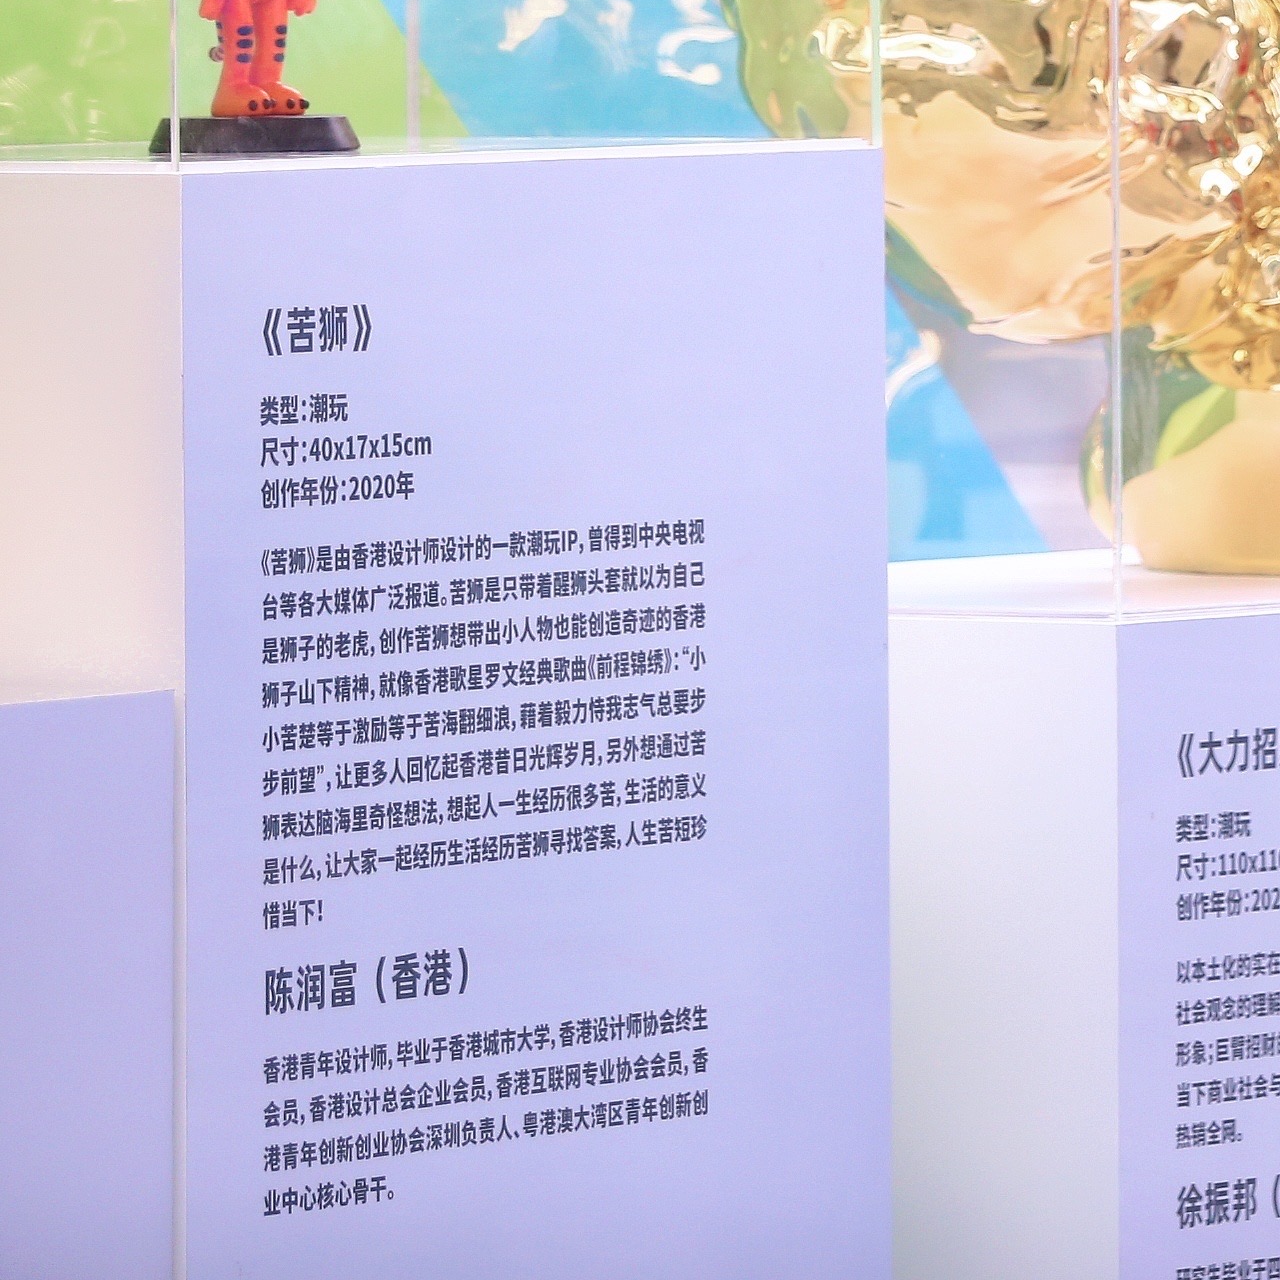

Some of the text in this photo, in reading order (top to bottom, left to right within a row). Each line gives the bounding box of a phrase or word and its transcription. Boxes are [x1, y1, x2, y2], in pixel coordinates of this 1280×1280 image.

[263, 304, 372, 356] 《苦狮》
[260, 394, 348, 425] 类型：潮玩
[261, 433, 432, 466] 尺寸：40x17x15cm
[261, 472, 414, 508] 创作年份：2020年
[1177, 812, 1250, 842] 类型：潮玩
[263, 900, 324, 929] 惜当下！
[265, 948, 469, 1014] 陈润富（香港）
[263, 1176, 395, 1216] 业中心核心骨干。
